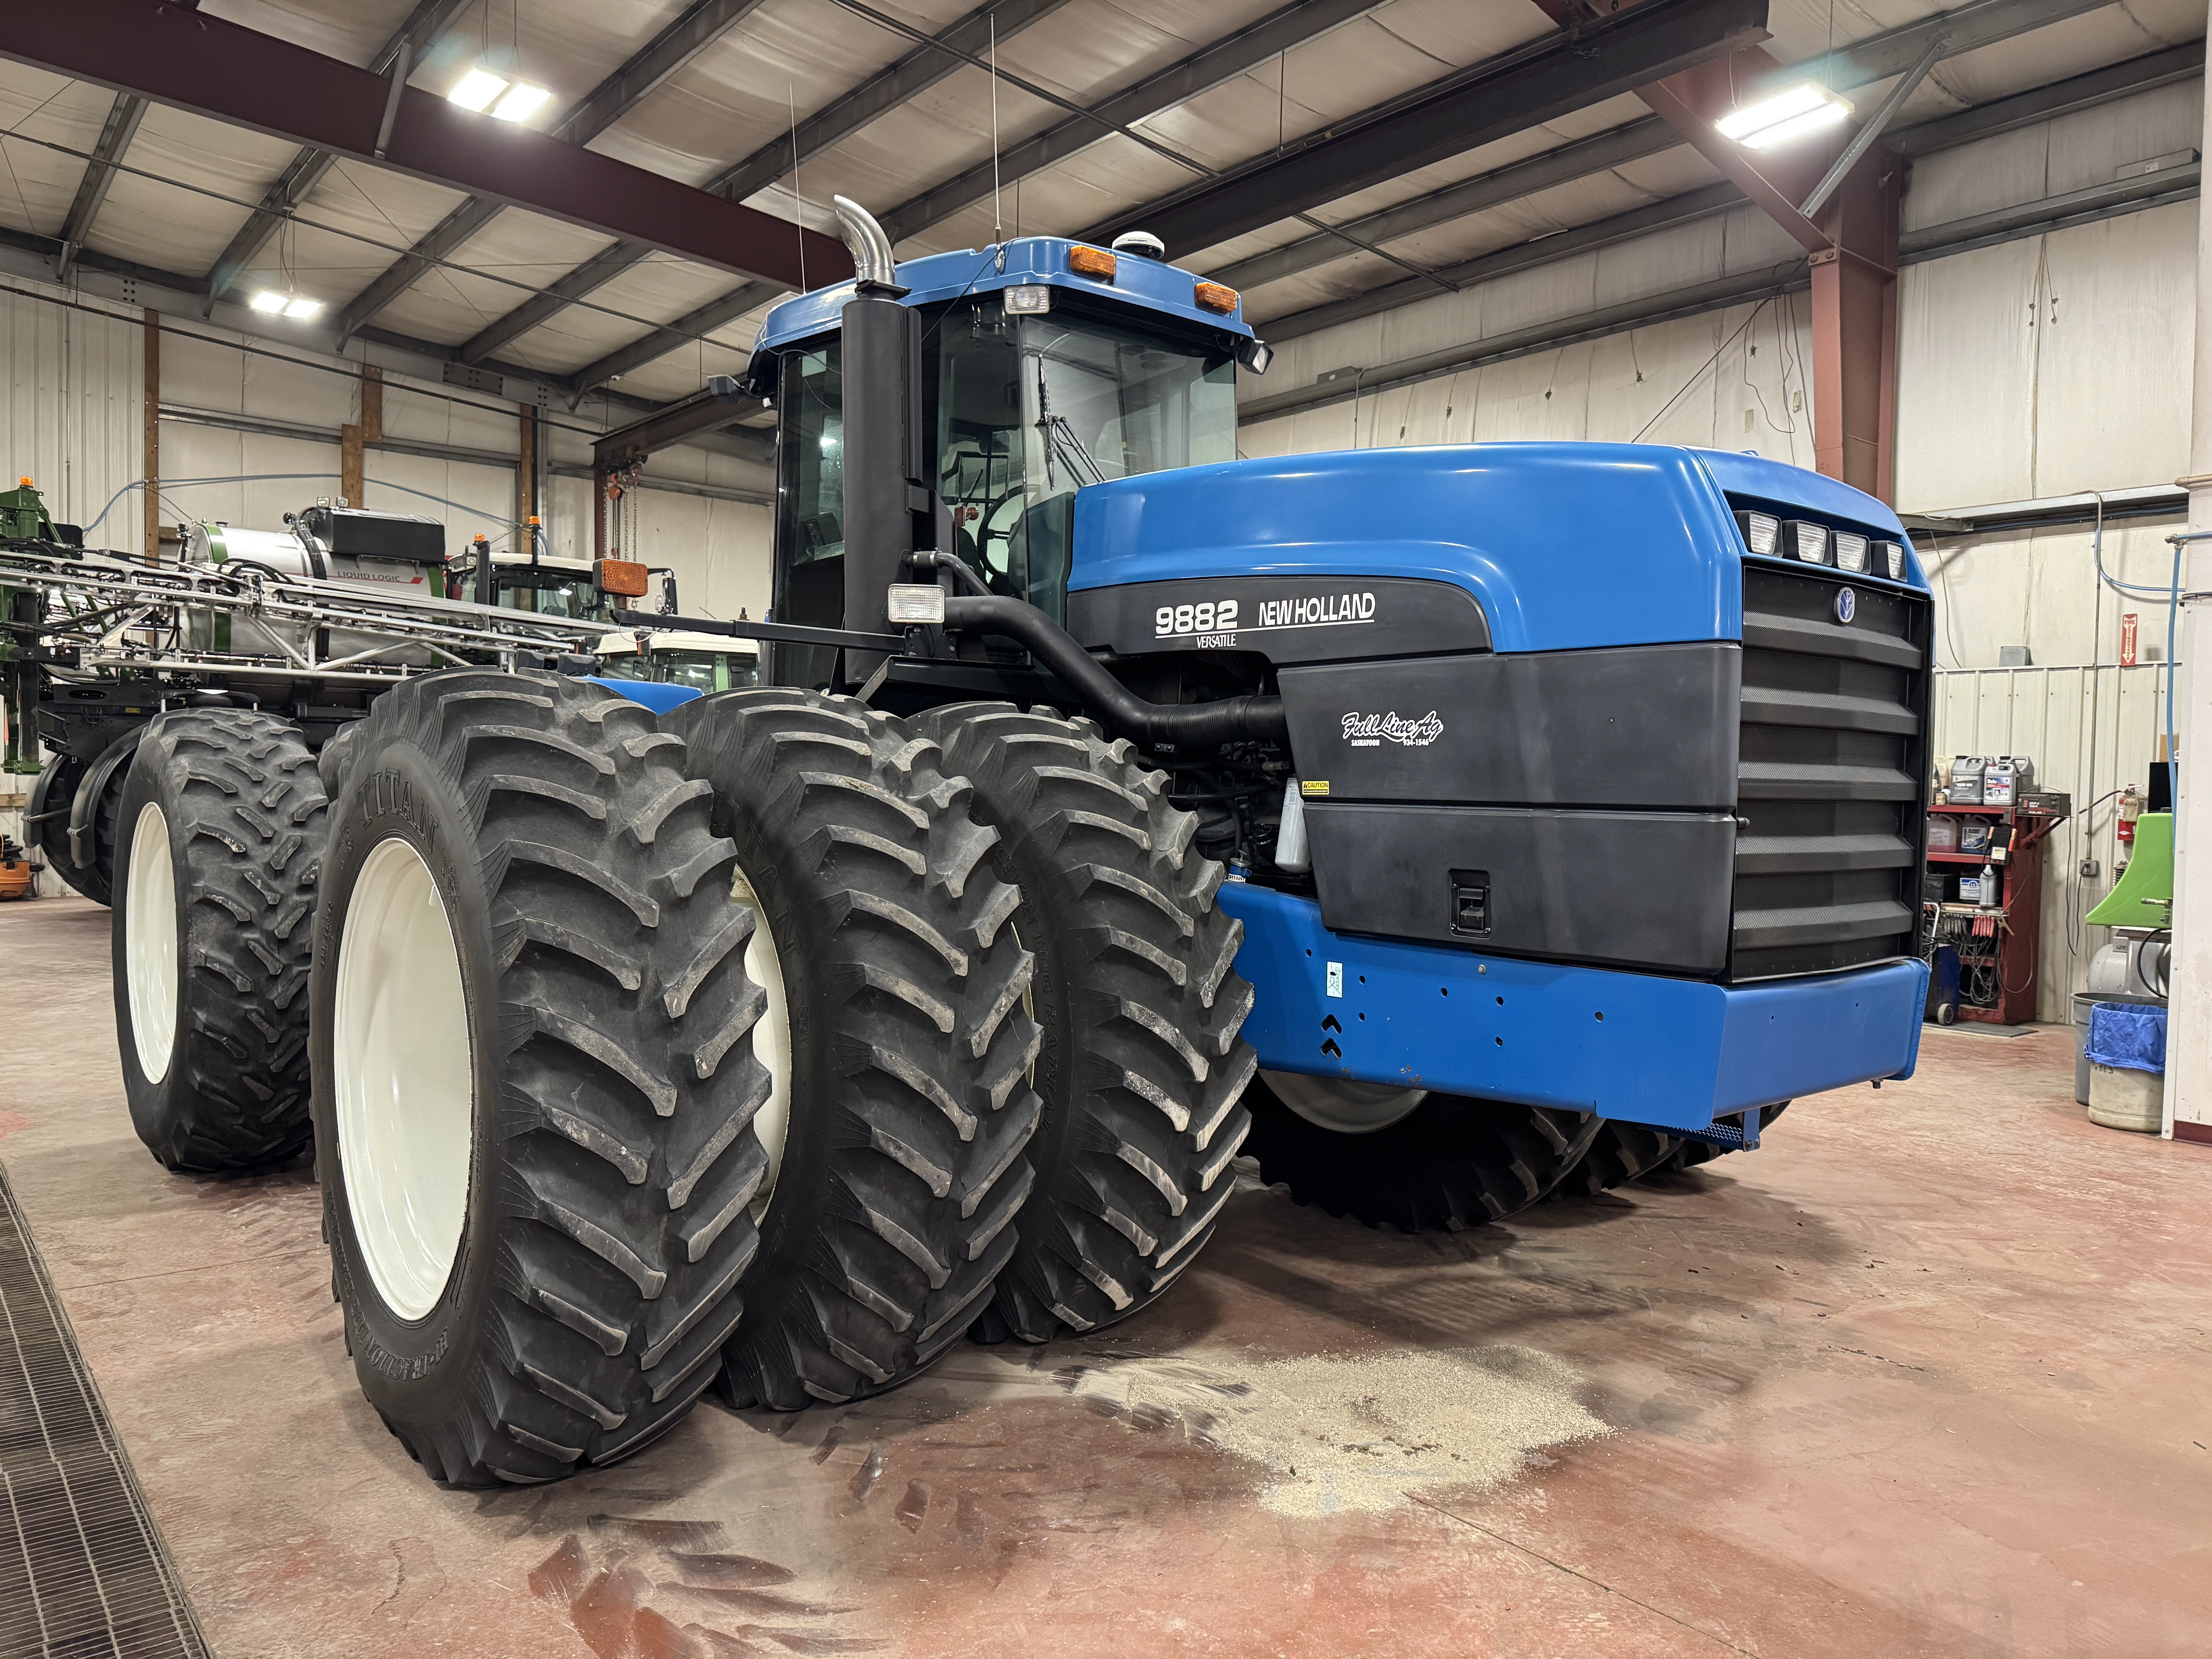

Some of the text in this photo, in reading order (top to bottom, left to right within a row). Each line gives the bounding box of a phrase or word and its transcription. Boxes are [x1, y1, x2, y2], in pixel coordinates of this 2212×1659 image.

[338, 571, 400, 582] LIQUID LOGIC
[1155, 592, 1376, 634] 9882 NEW HOLLAND
[1196, 634, 1236, 649] VERSATILE
[1341, 710, 1444, 743] Full Line Ag
[1351, 738, 1380, 747] SASKATOON
[356, 767, 439, 855] TITAN
[351, 1297, 370, 1344] LUG
[362, 1326, 448, 1382] HI-TRACTION
